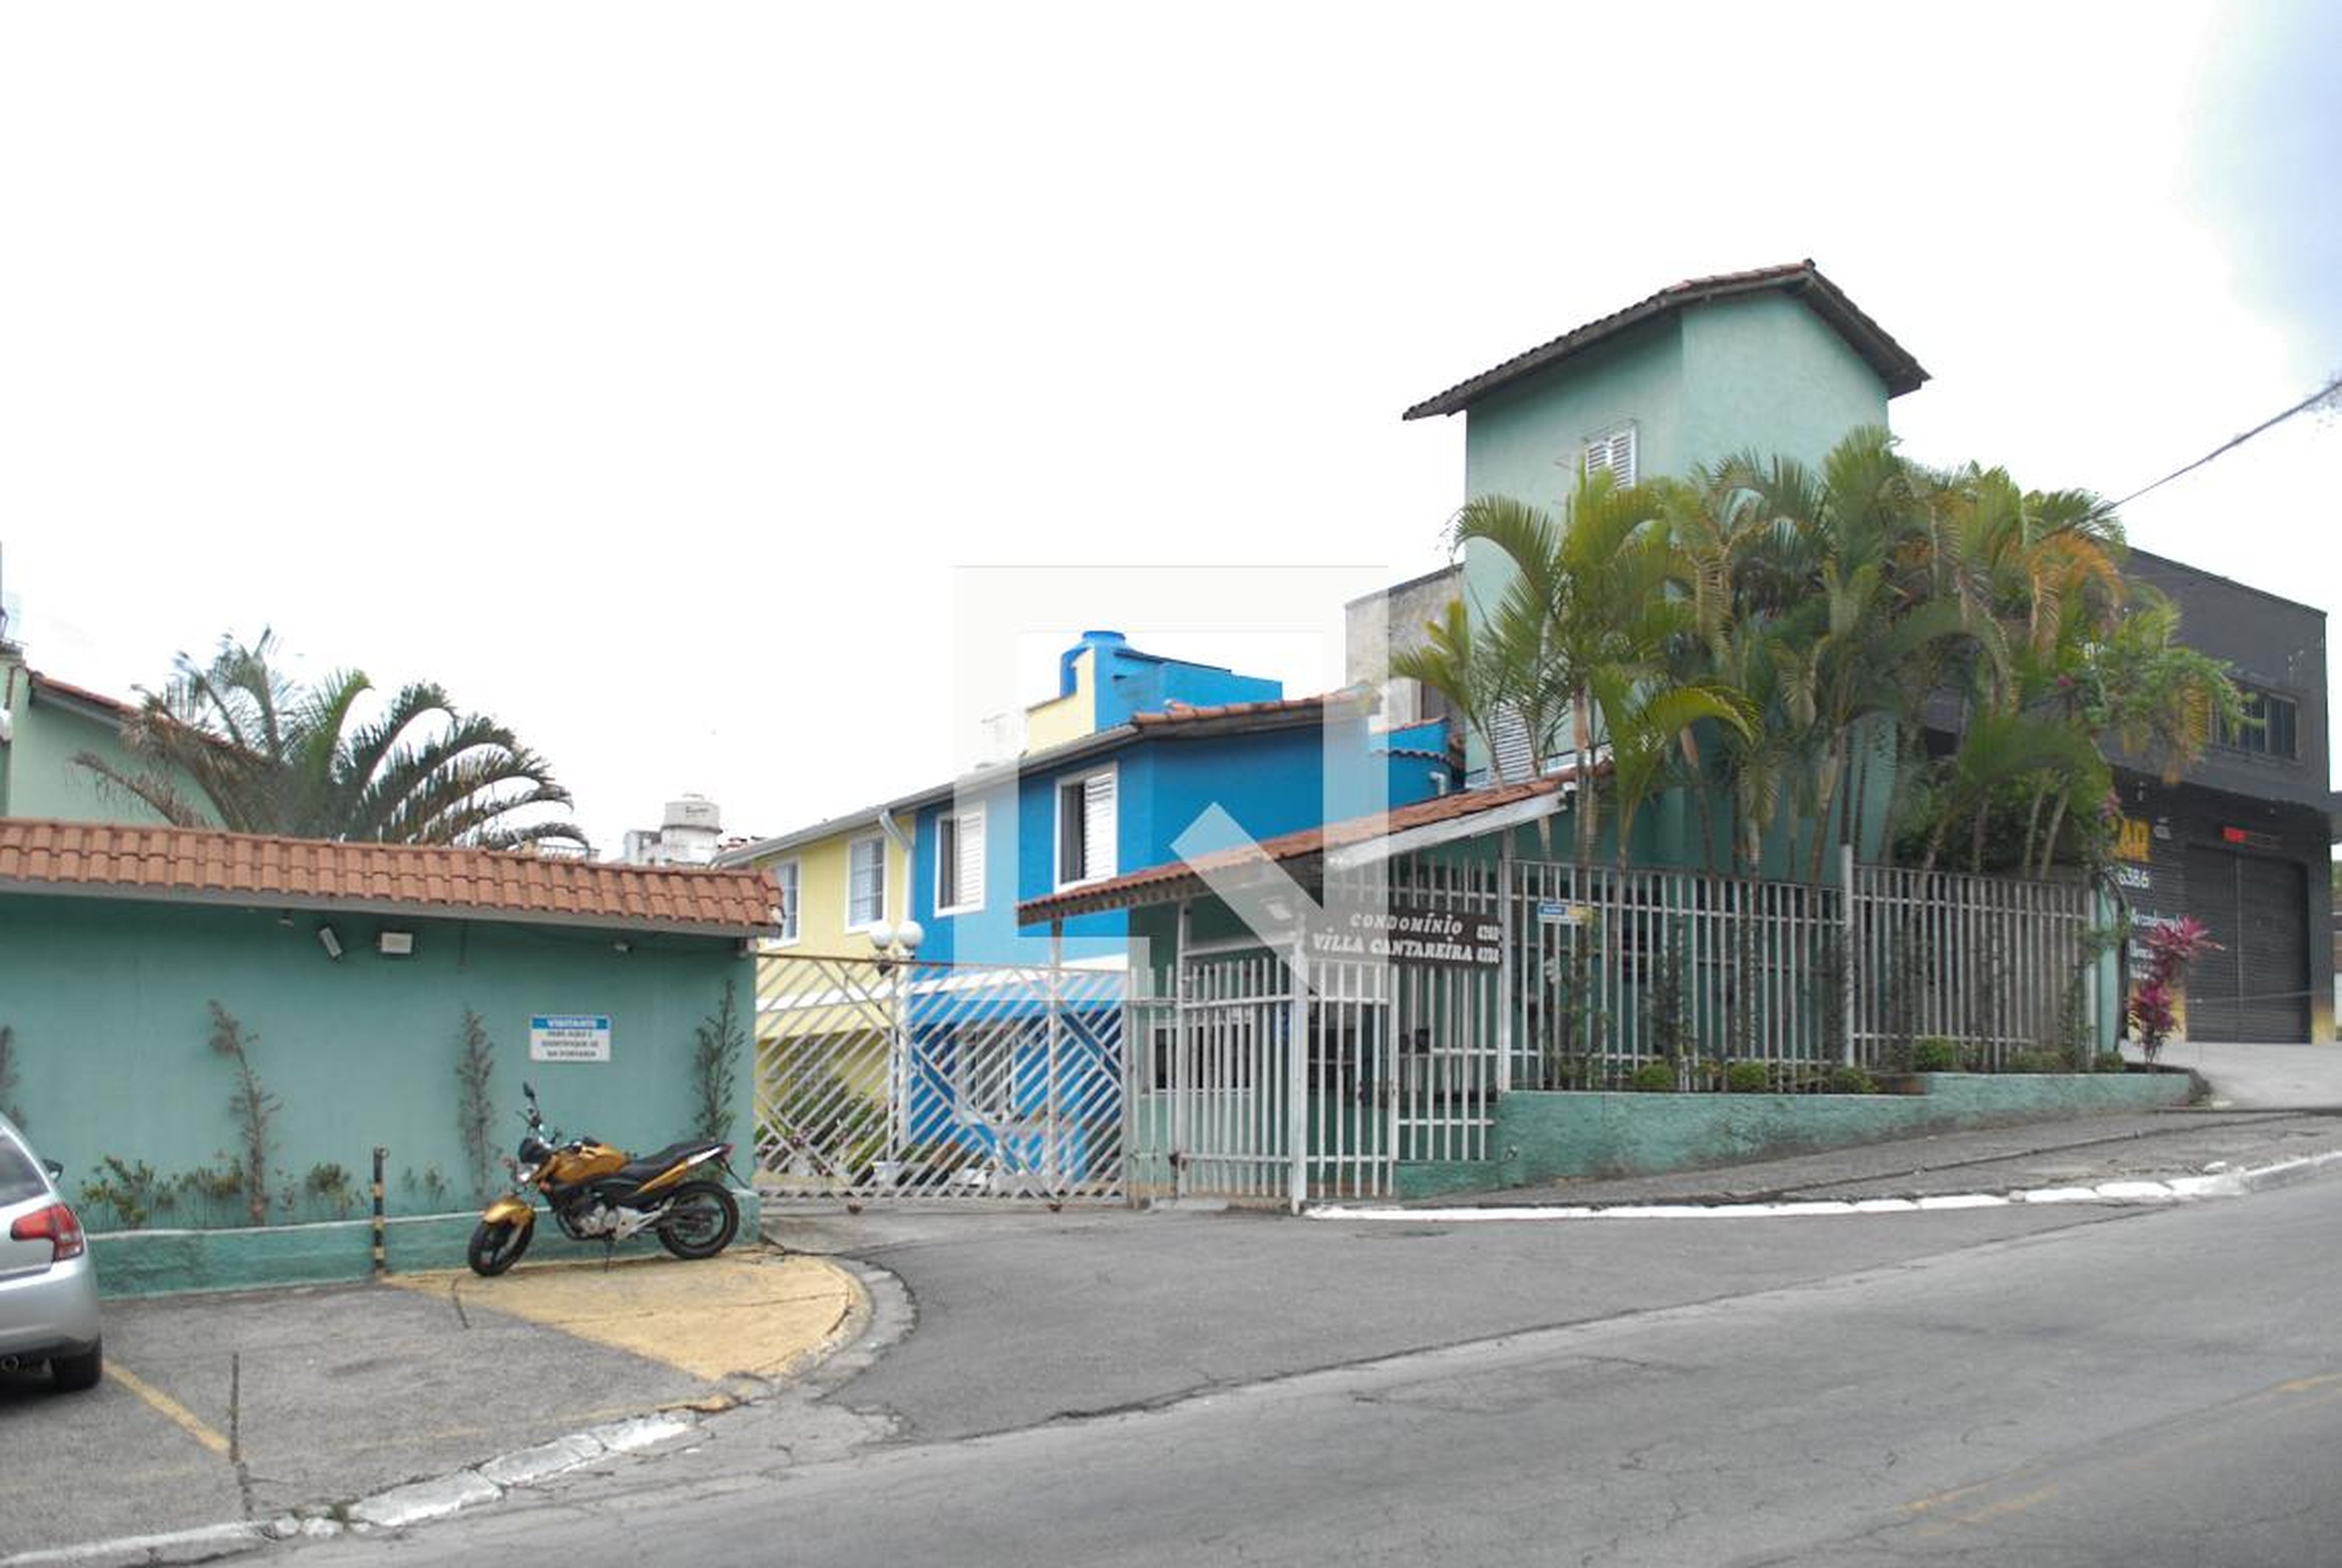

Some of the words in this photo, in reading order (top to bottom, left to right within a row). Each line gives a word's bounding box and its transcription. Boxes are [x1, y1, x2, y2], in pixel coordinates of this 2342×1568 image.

[1349, 912, 1463, 935] CONDOMÍNIO
[1312, 927, 1364, 953] VILLA
[1369, 936, 1473, 961] CANTAREIRA
